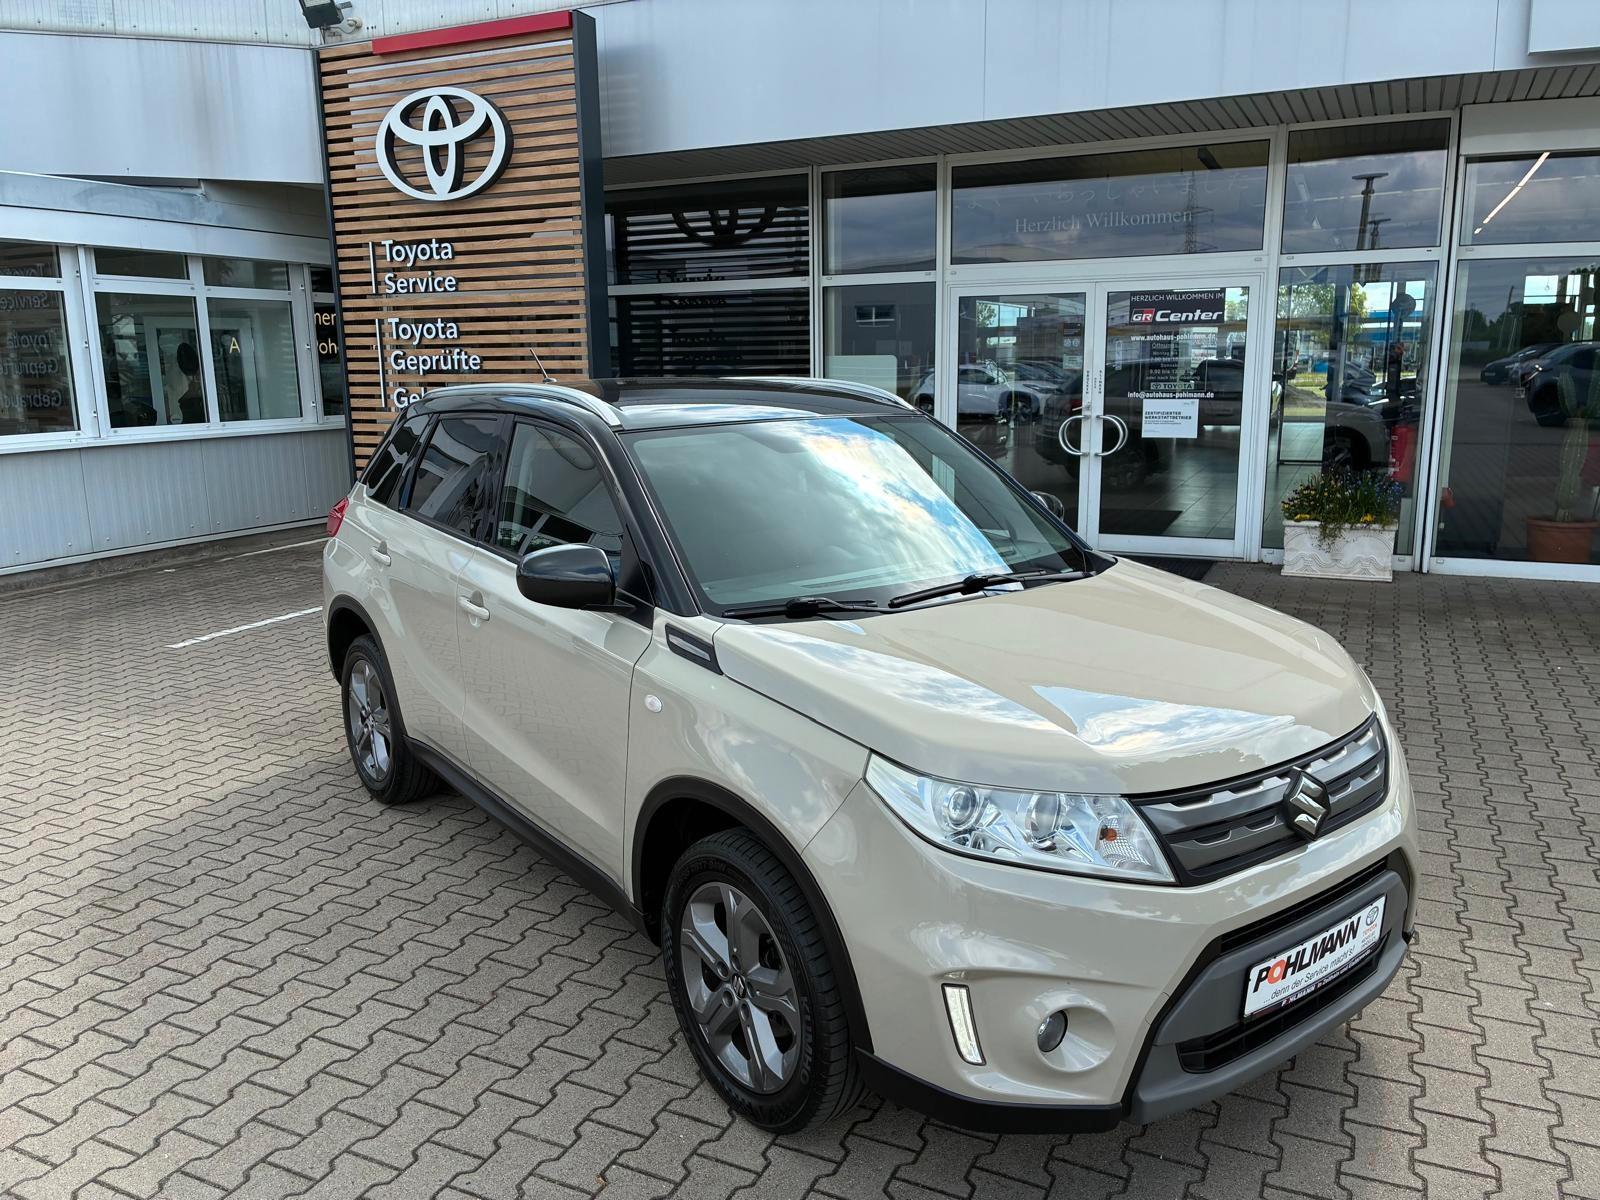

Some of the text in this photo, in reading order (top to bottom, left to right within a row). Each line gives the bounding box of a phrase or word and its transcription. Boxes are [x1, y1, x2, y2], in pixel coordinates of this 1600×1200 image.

[1015, 209, 1192, 234] Herzlich Willkommen
[381, 238, 453, 267] Toyota
[384, 271, 457, 294] Service
[1131, 294, 1164, 302] HERZLICH
[1166, 293, 1214, 301] WILLKOMMEN
[1132, 309, 1223, 322] GR Center
[387, 318, 458, 346] Toyota
[390, 348, 481, 375] Geprüfte
[1128, 391, 1214, 399] info@autohaus-pohlmann.de
[1253, 916, 1361, 993] POHLMANN
[1291, 977, 1304, 989] der
[1304, 964, 1329, 983] Service
[799, 995, 814, 1085] KUMHO
